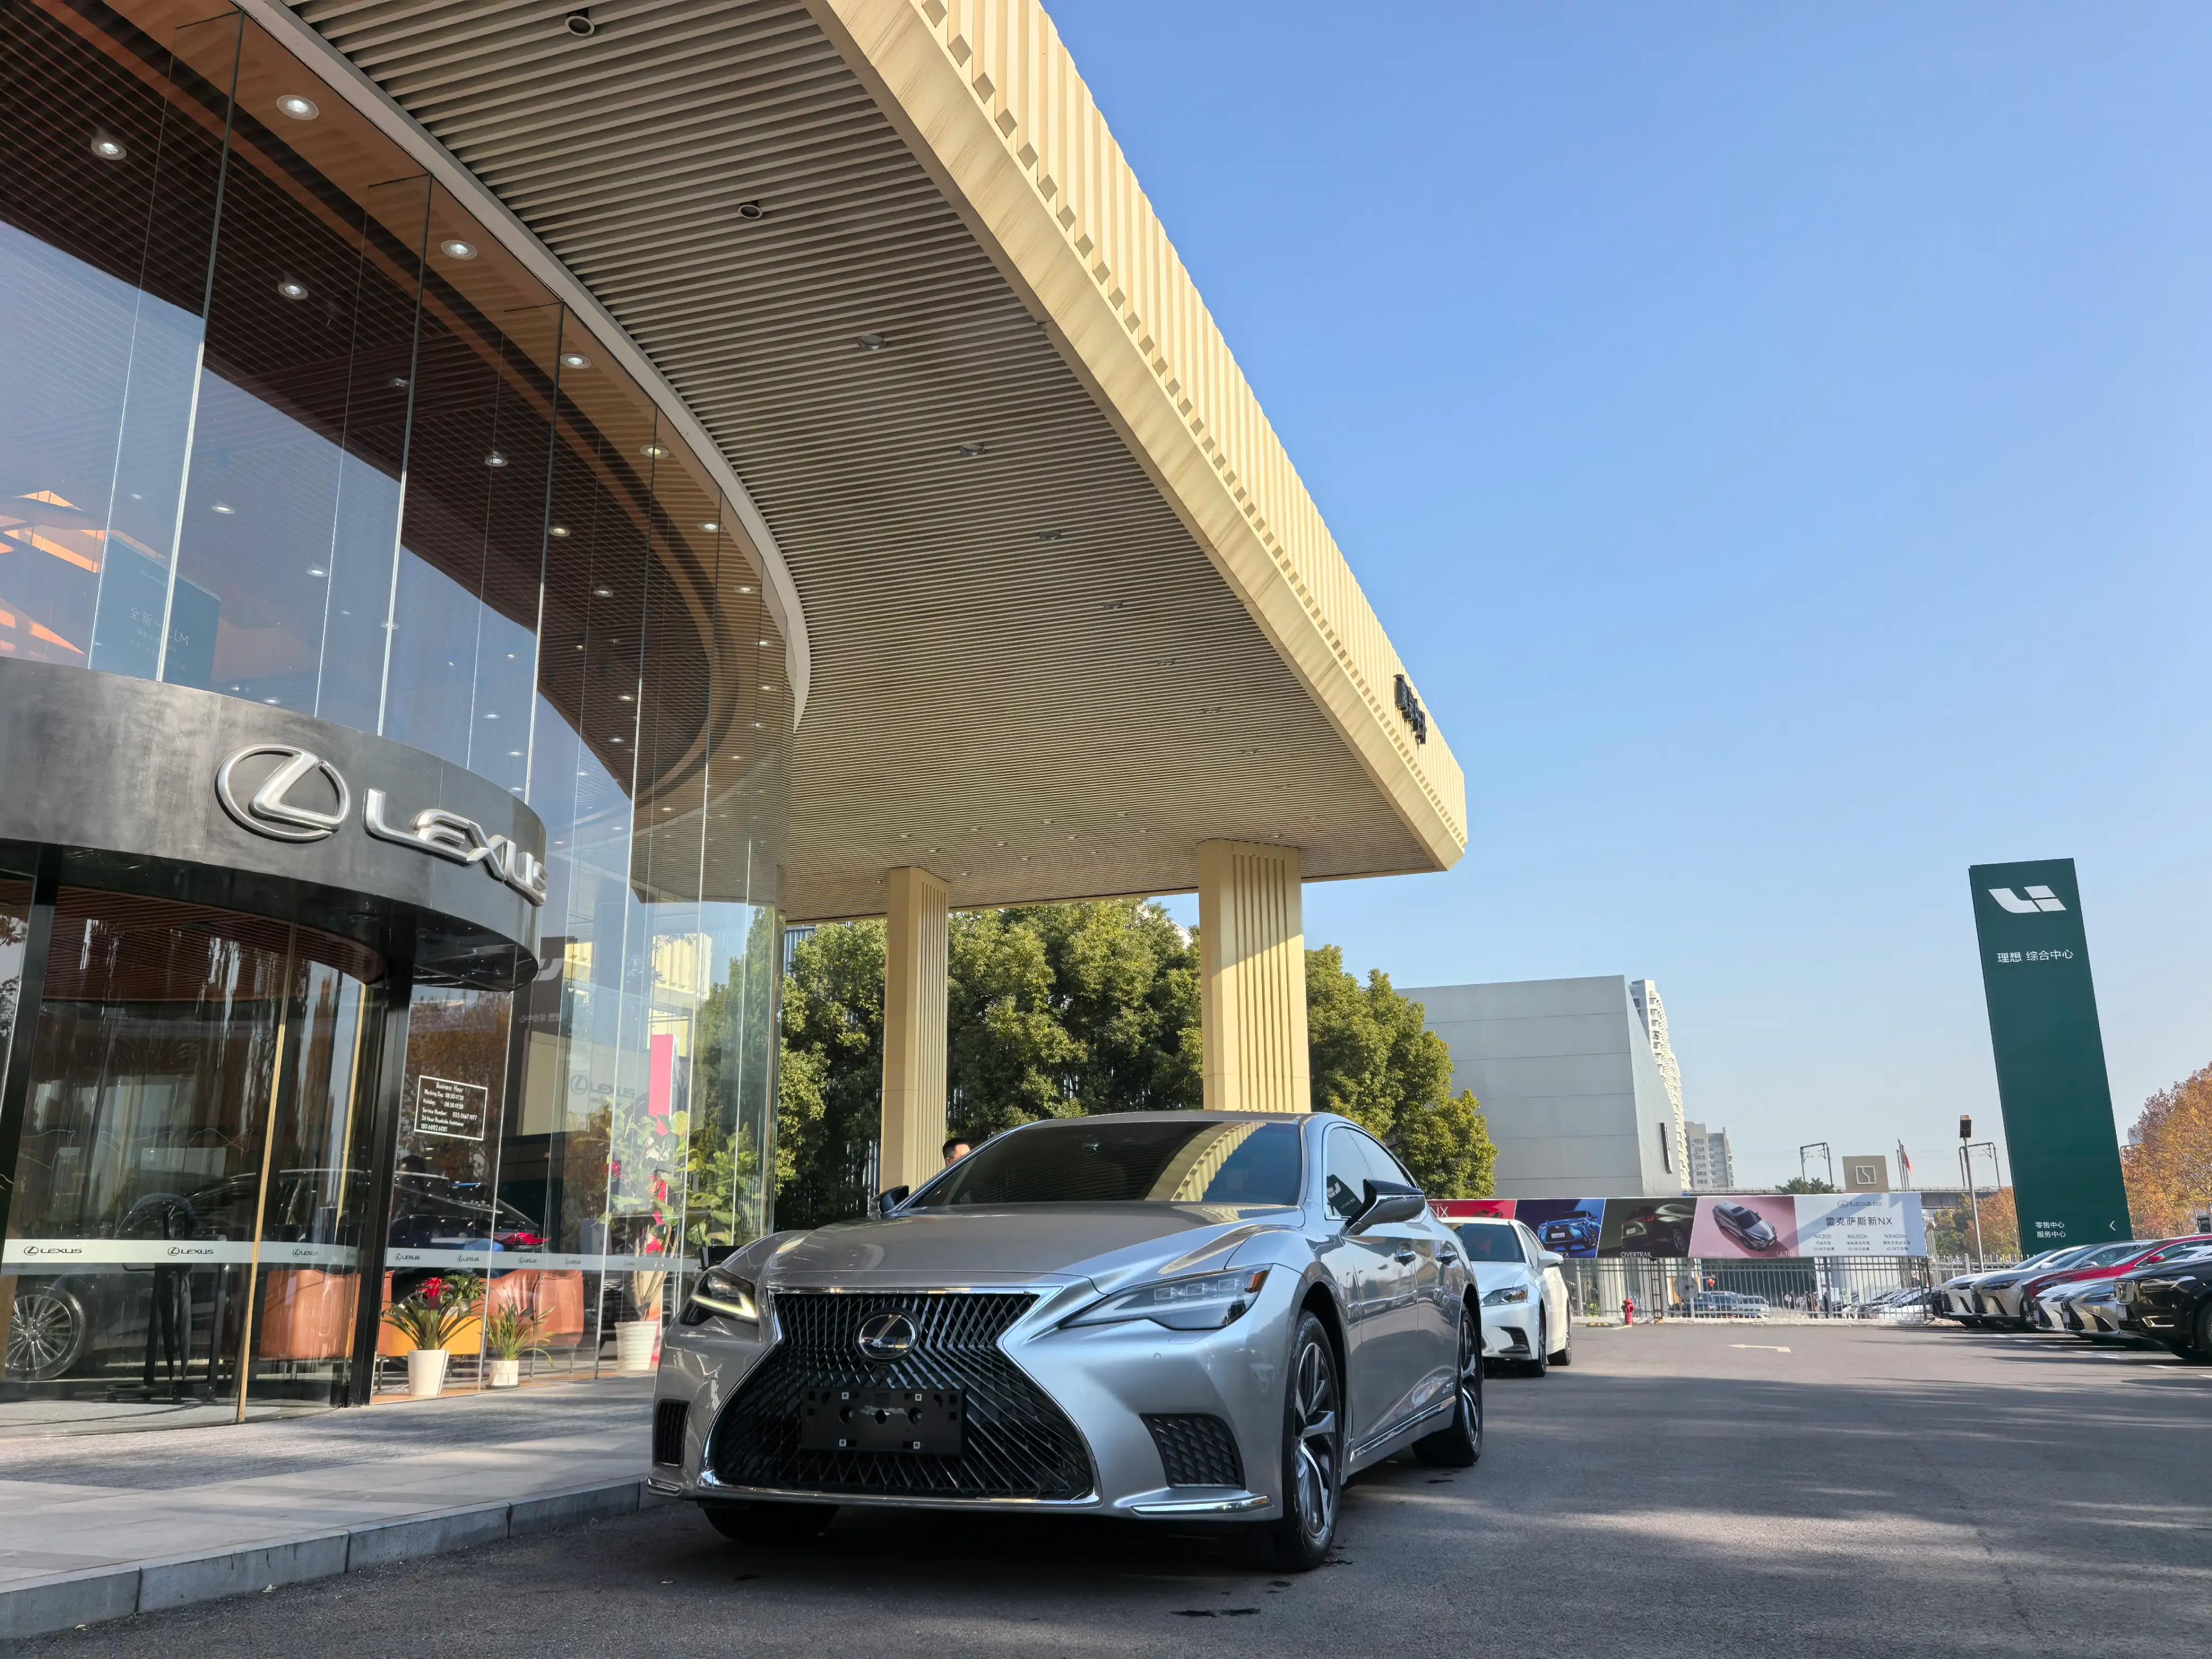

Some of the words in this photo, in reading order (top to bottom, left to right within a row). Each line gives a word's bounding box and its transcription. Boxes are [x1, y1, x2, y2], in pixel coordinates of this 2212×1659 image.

[362, 787, 548, 907] LEXUS
[1997, 952, 2022, 963] 理想
[2025, 949, 2074, 961] 综合中心
[436, 1082, 452, 1091] Business
[424, 1089, 437, 1097] Working
[1825, 1217, 1893, 1226] 雷克萨斯新NX
